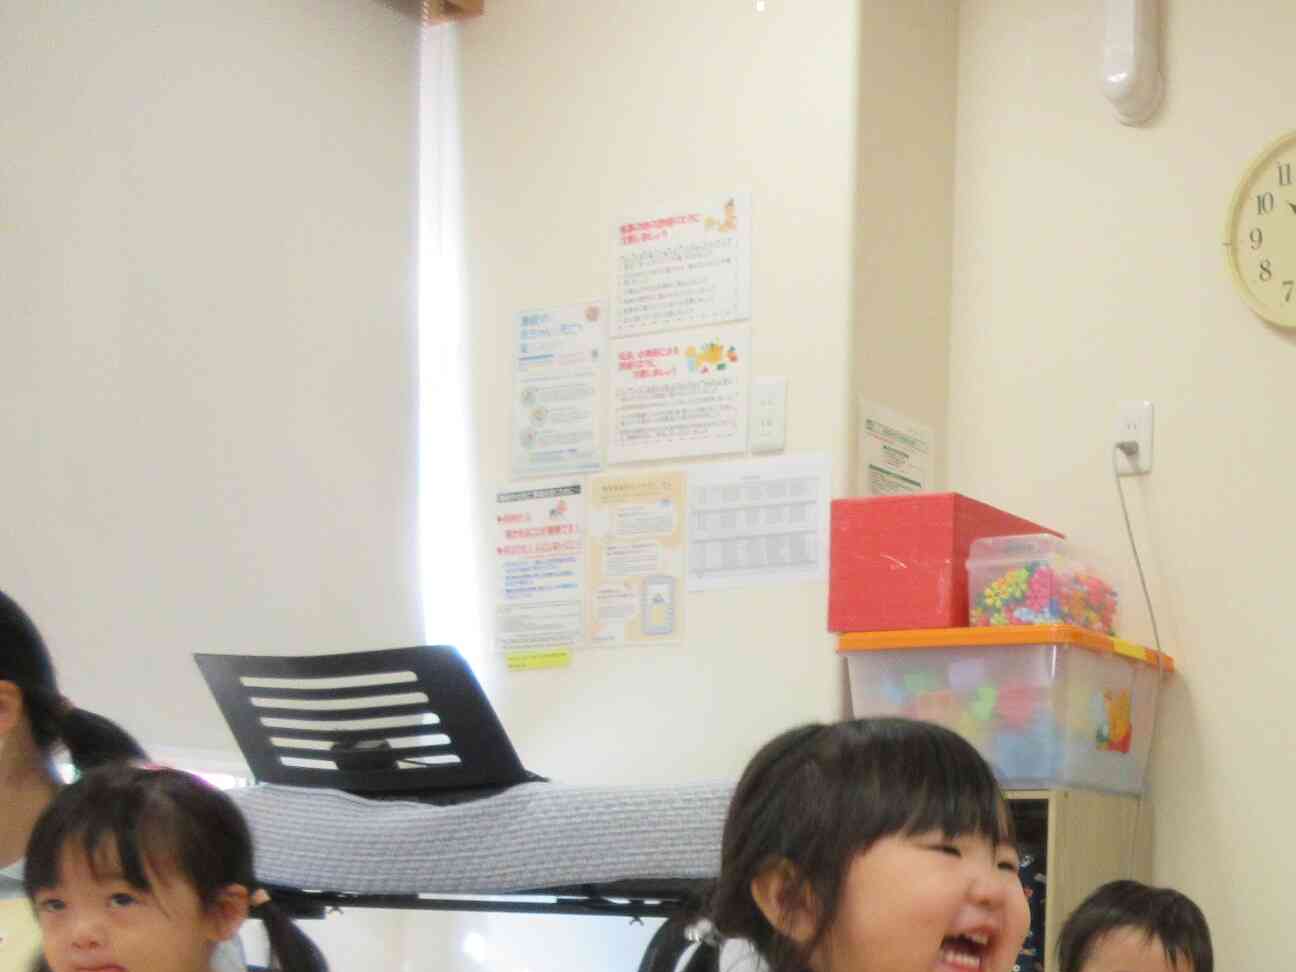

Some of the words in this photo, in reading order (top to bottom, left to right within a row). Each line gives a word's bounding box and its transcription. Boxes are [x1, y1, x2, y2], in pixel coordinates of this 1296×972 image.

[1278, 163, 1293, 186] 11
[1257, 192, 1274, 214] 10
[1249, 227, 1264, 251] 9
[1259, 259, 1273, 281] 8
[1282, 281, 1294, 302] 7
